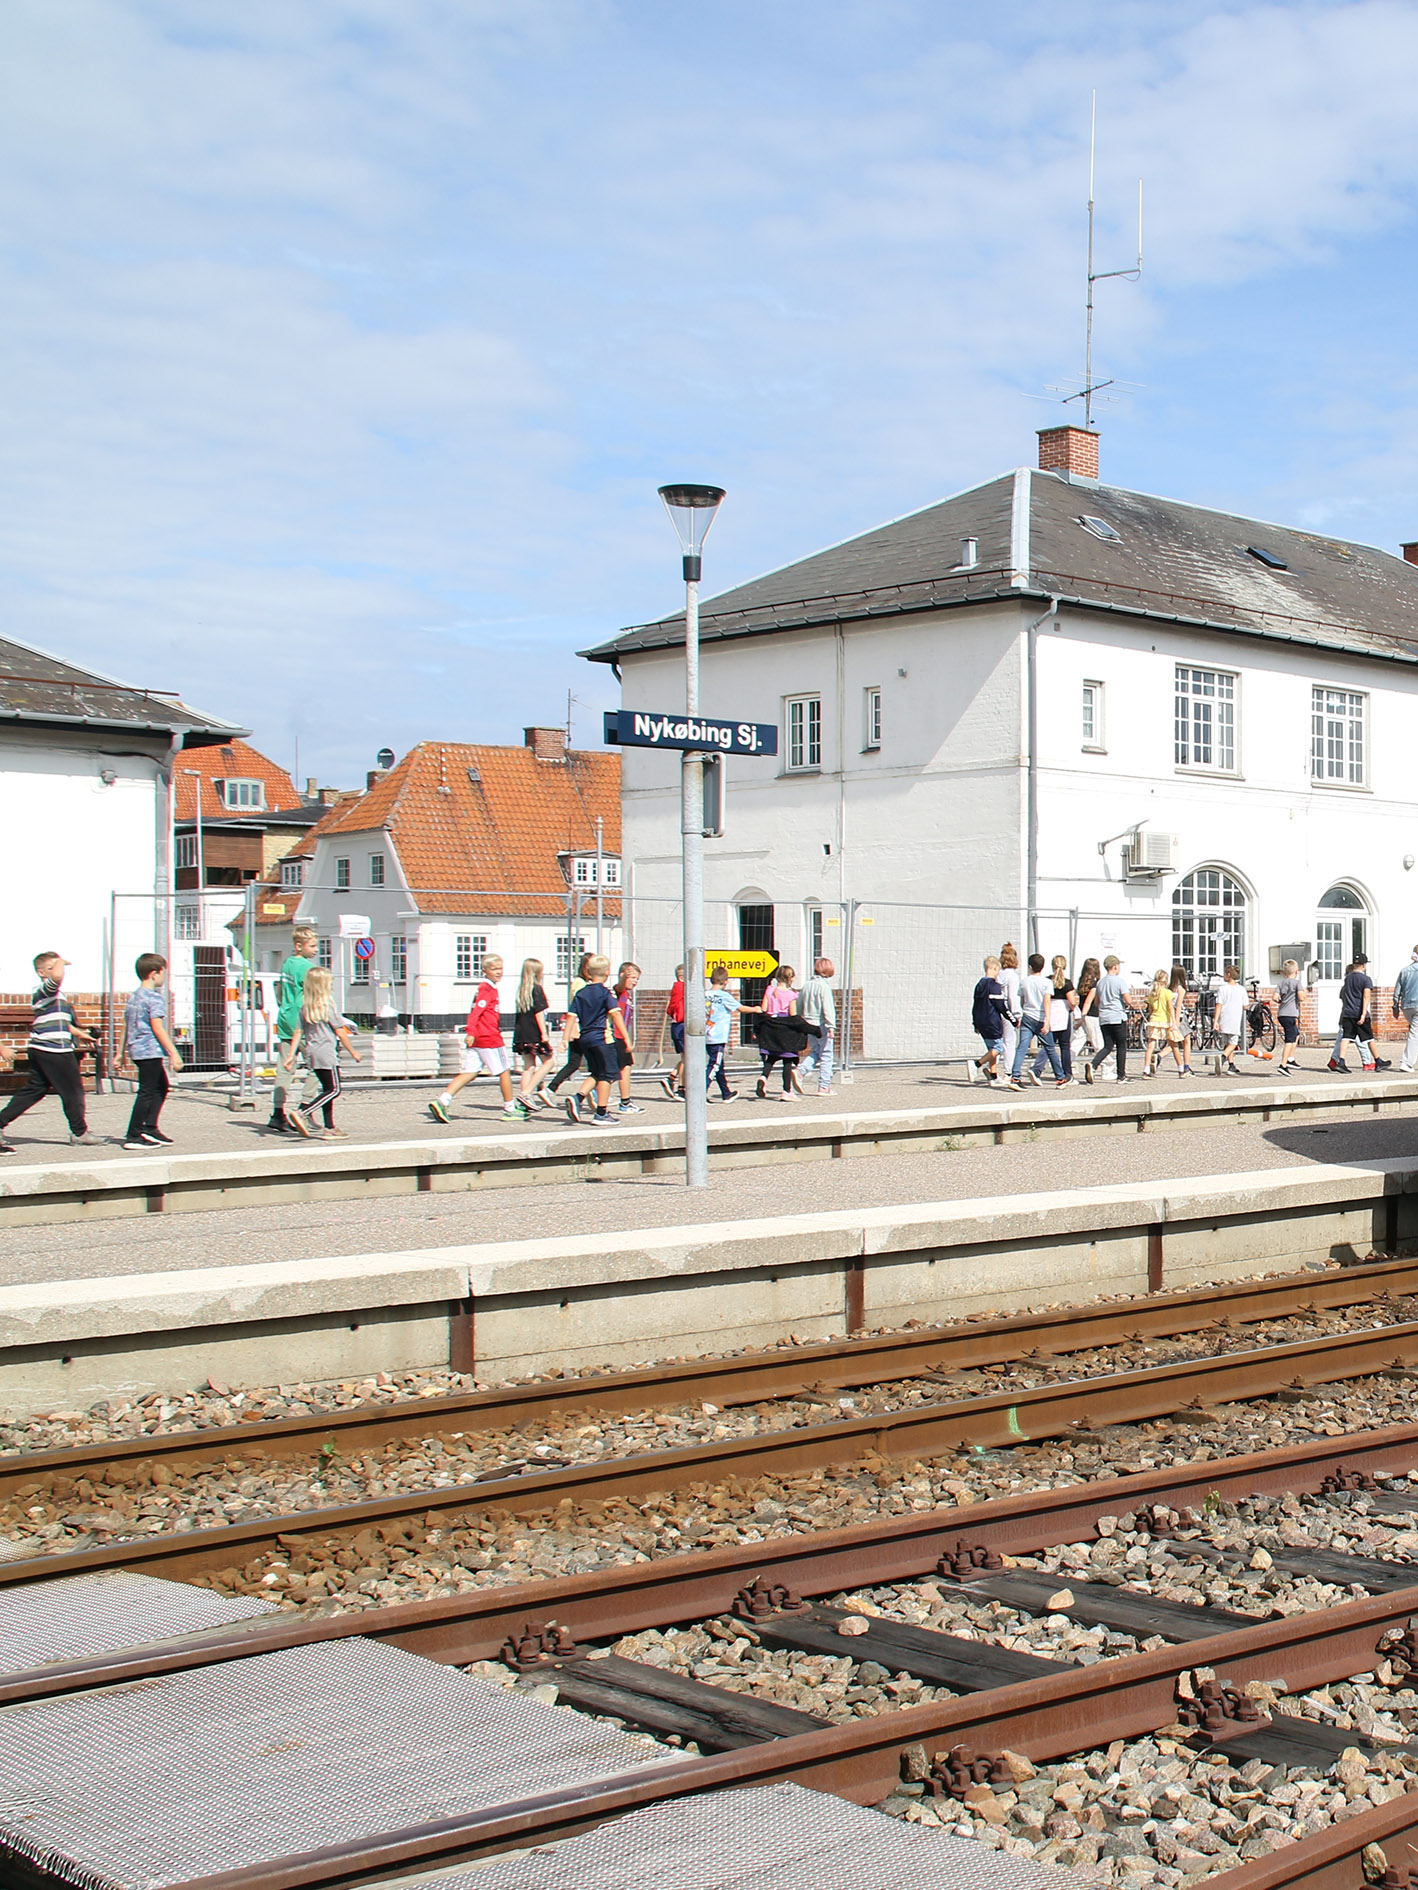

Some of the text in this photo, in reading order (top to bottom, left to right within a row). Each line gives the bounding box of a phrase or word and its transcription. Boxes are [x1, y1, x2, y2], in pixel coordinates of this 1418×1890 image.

[634, 714, 763, 751] Nykøbing Sj.
[706, 958, 766, 972] rnbanevej
